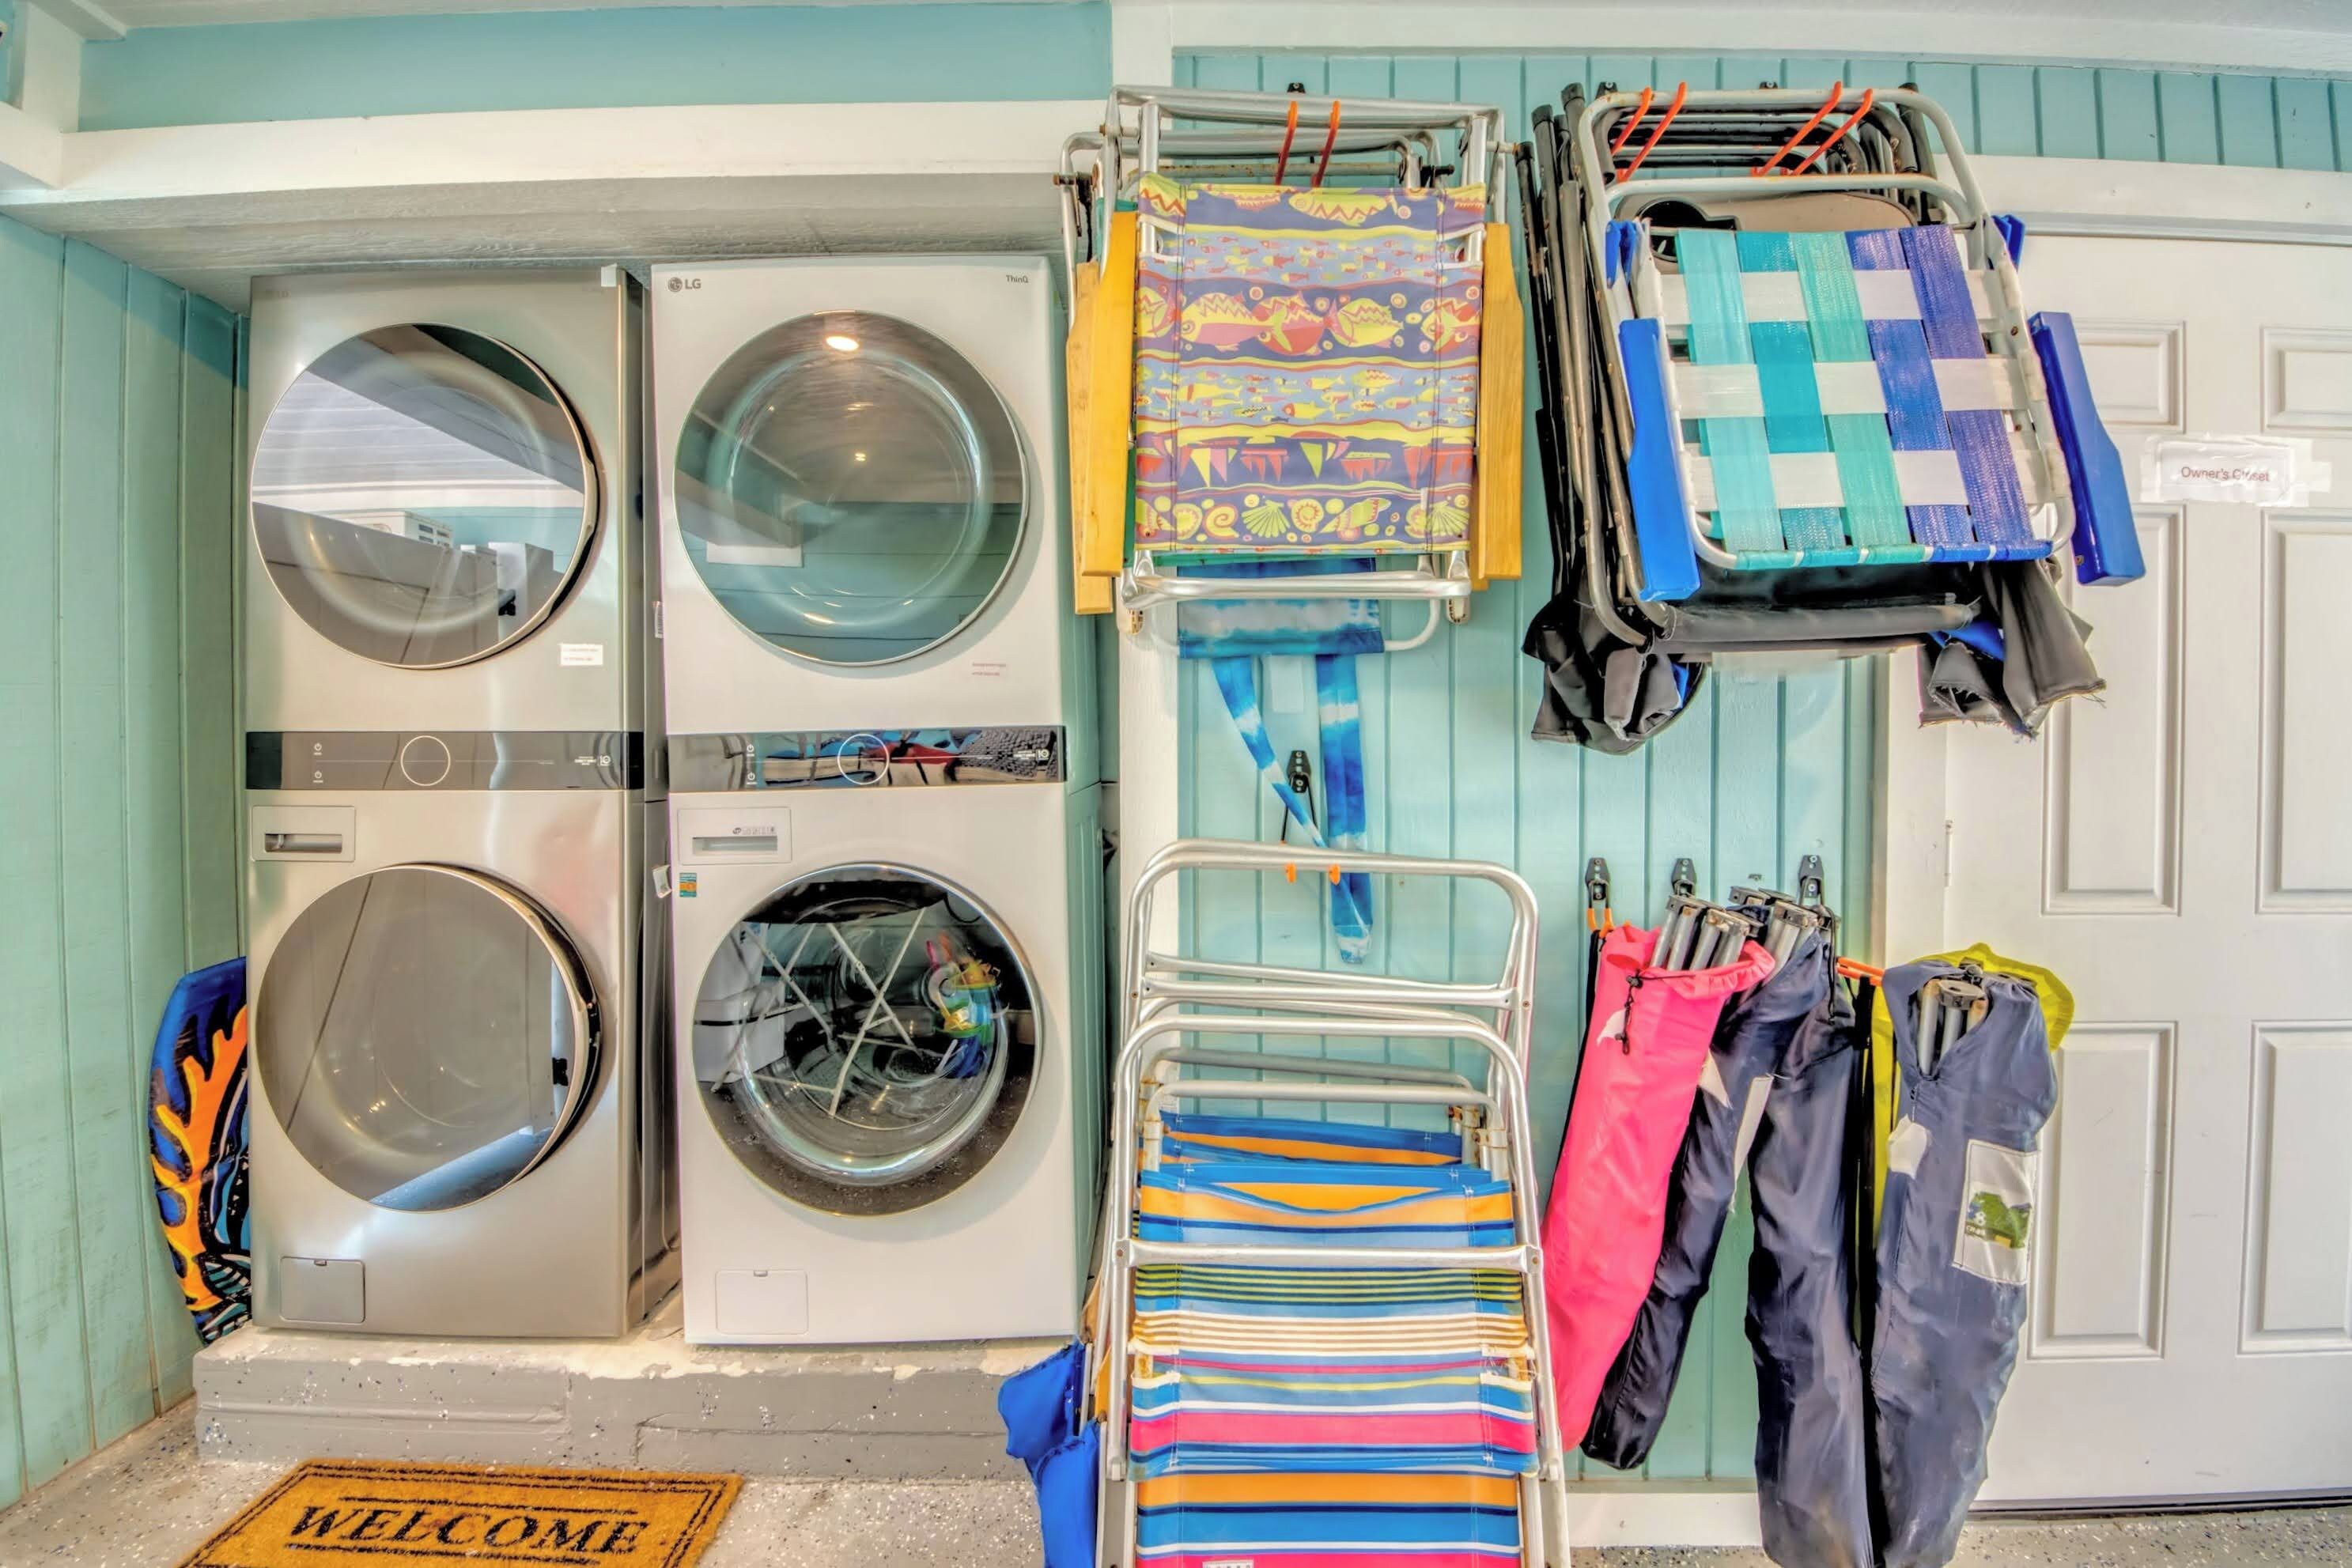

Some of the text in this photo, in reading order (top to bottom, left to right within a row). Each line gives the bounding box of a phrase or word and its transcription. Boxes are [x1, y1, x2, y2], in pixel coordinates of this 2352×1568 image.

[685, 278, 701, 290] LG
[1005, 274, 1029, 284] ThinQ
[2181, 466, 2229, 481] Owner's
[290, 1506, 649, 1553] WELCOME
